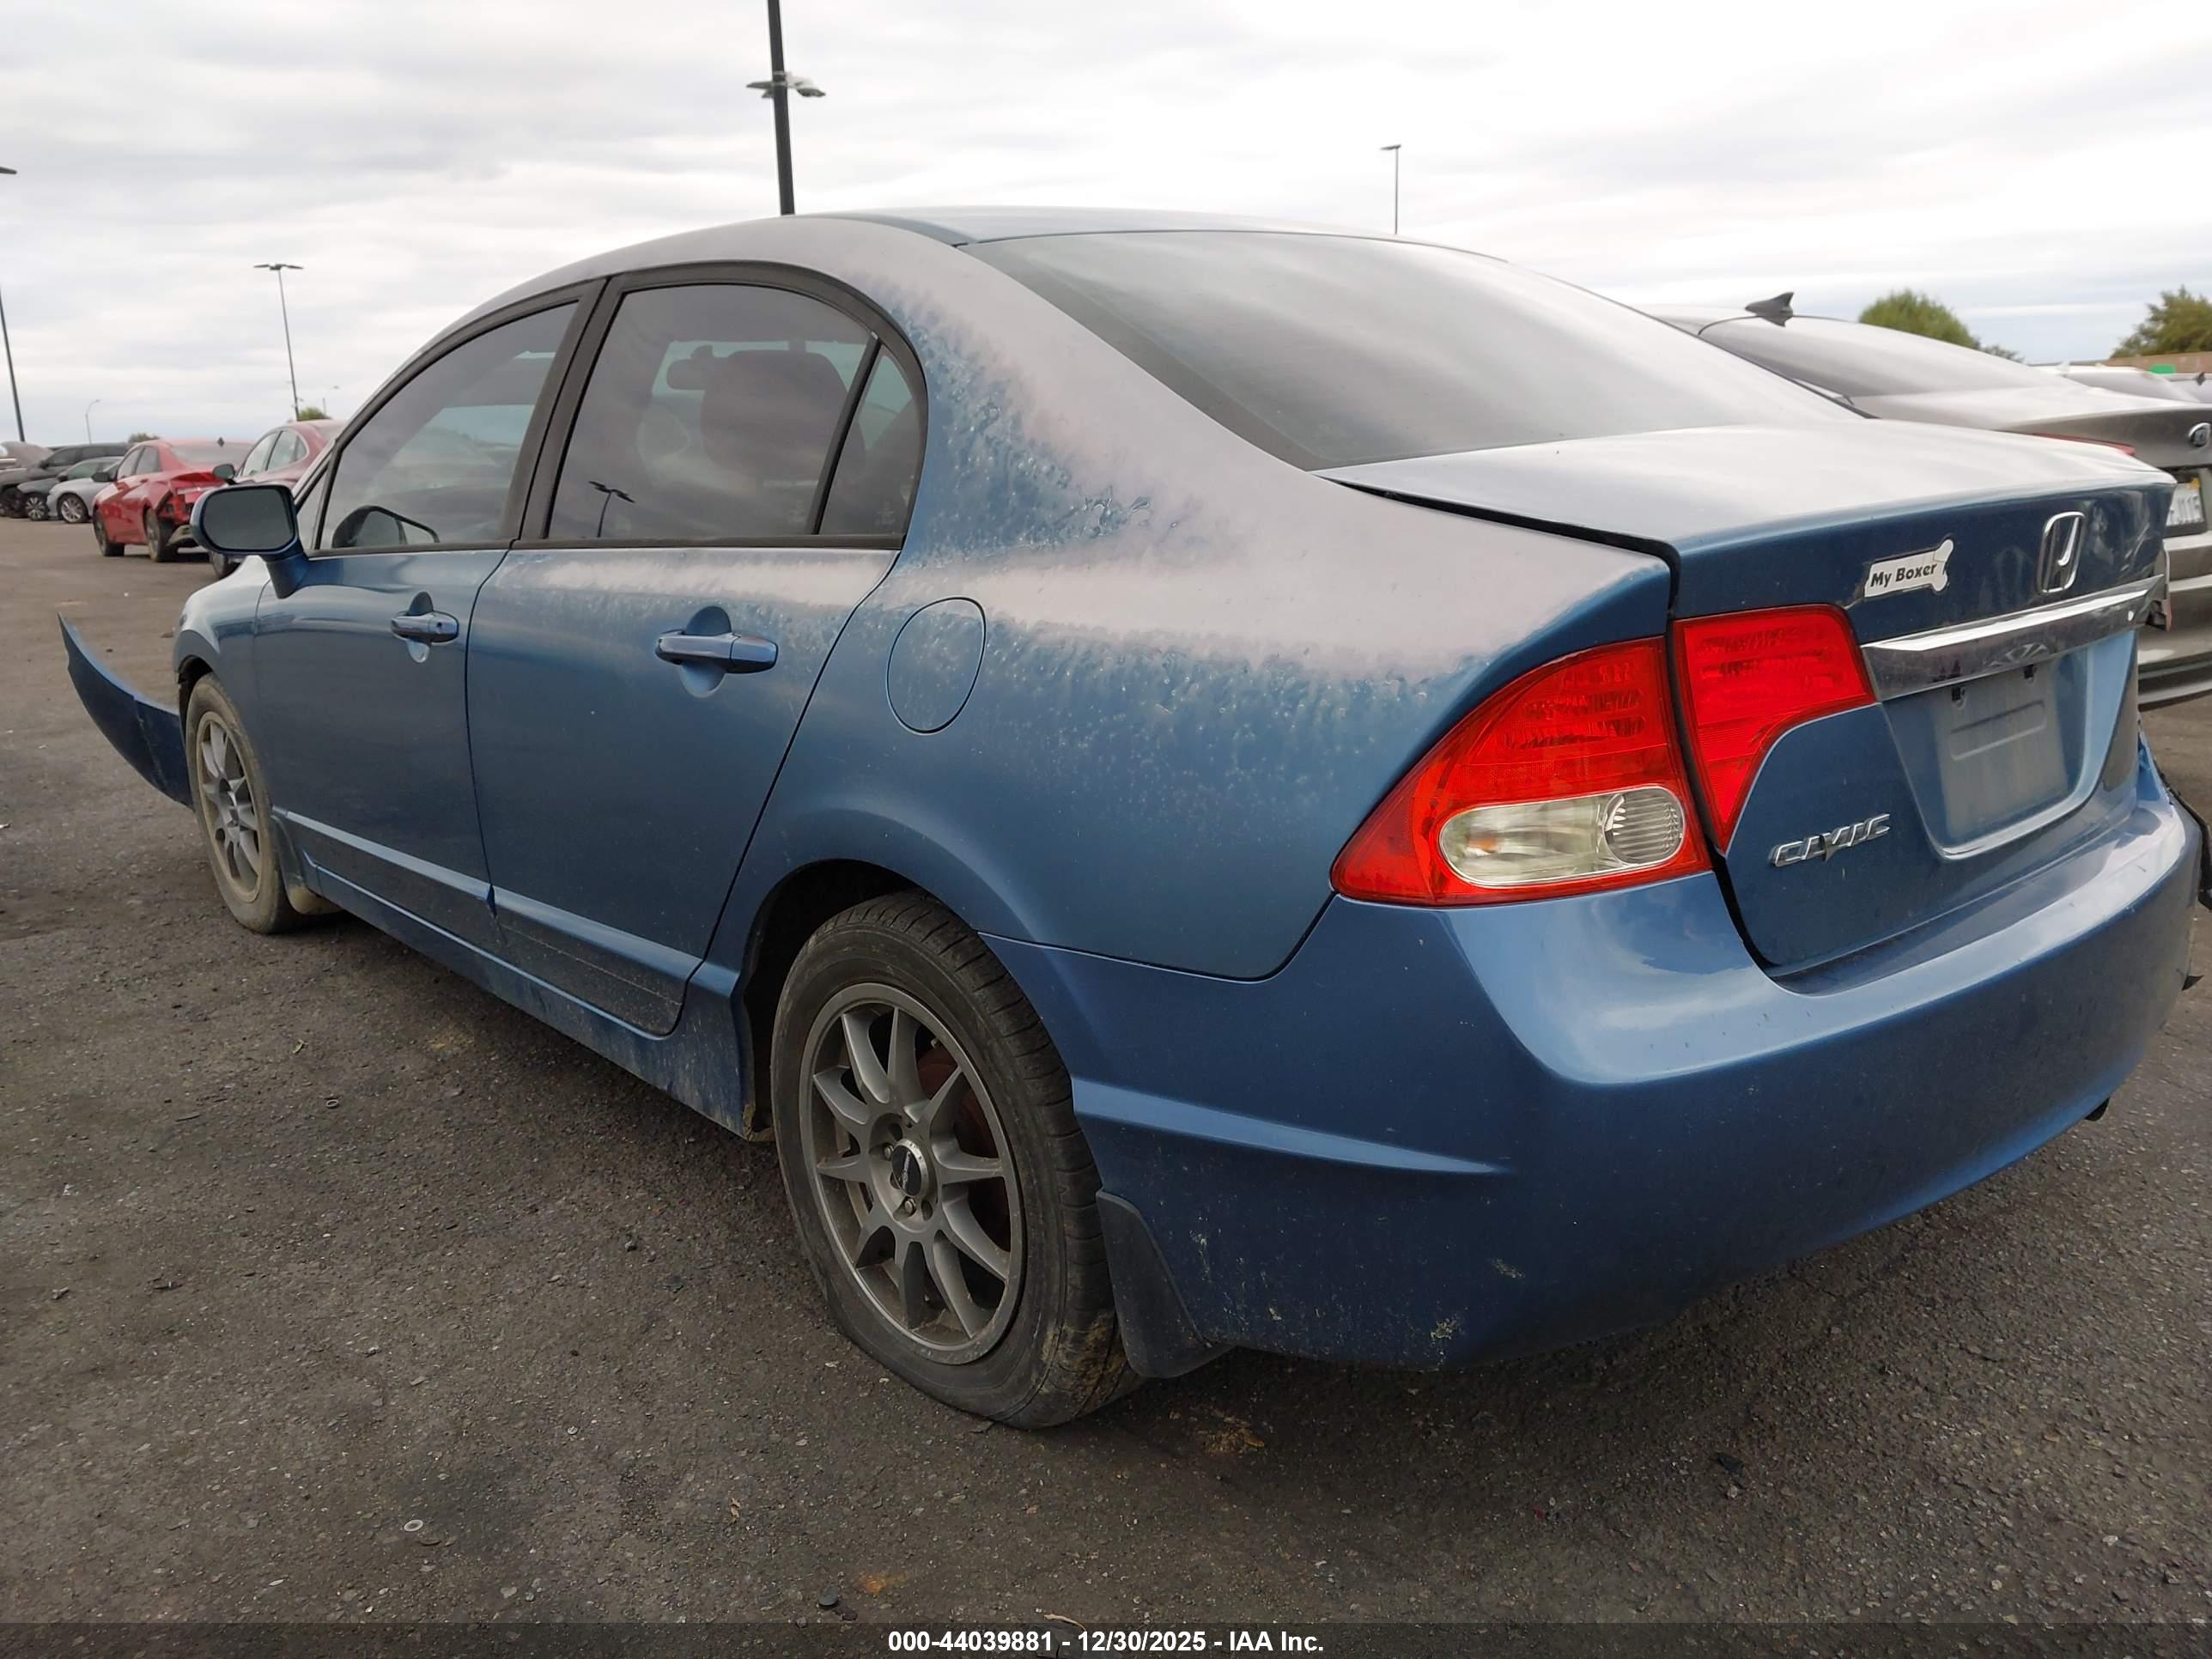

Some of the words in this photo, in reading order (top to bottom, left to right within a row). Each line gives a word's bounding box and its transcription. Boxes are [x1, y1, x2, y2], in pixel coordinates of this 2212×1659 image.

[1870, 571, 1892, 588] My
[1895, 563, 1938, 582] Boxer
[1771, 813, 1891, 868] CIVIC
